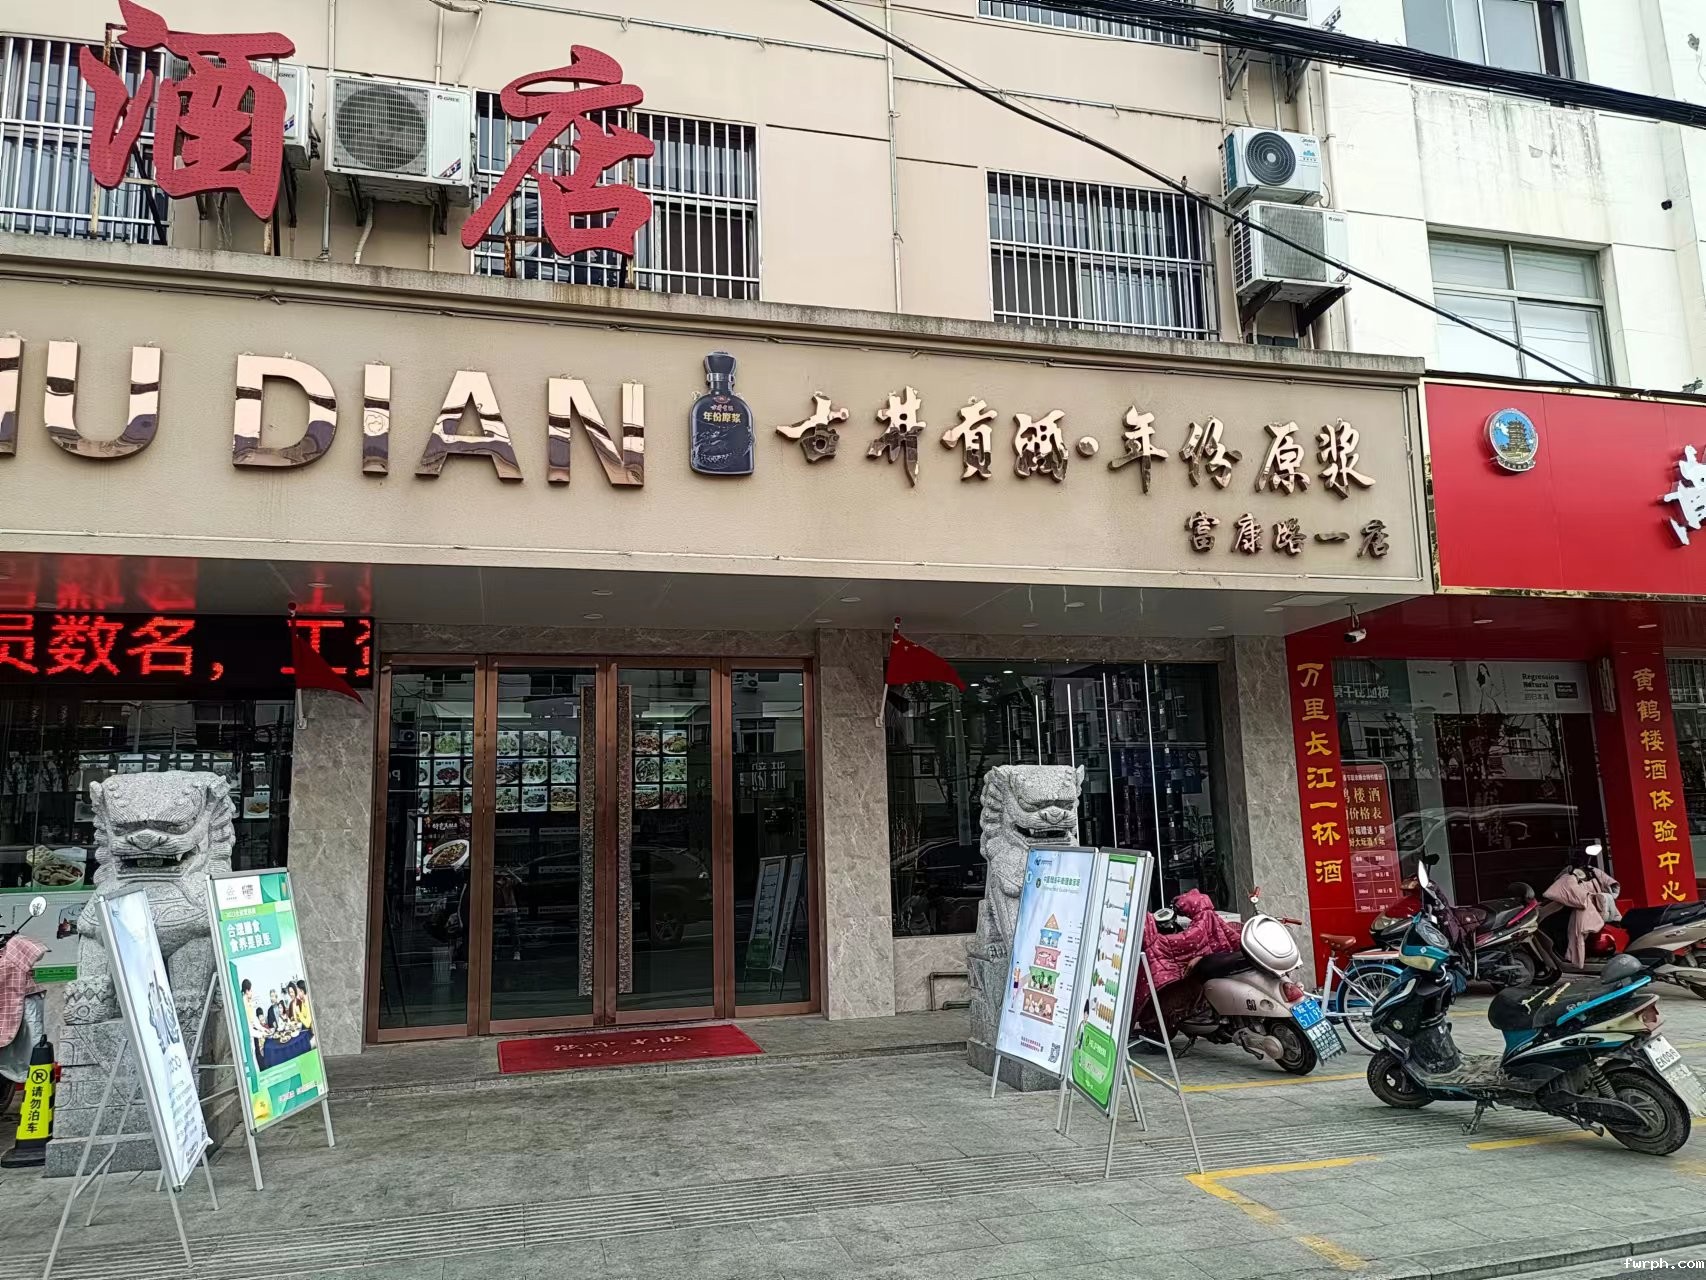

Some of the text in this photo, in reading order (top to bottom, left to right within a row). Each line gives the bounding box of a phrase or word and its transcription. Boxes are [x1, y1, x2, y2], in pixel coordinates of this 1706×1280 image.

[79, 0, 655, 257] 酒店
[232, 353, 646, 488] DIAN
[1185, 511, 1391, 559] 富康路一店
[1297, 662, 1344, 885] 万里长江一杯酒
[1345, 806, 1383, 821] 价格表
[1632, 667, 1687, 902] 黄鹤楼酒体验中心
[1299, 1007, 1324, 1027] 57193
[26, 1086, 44, 1134] 请勿泊车
